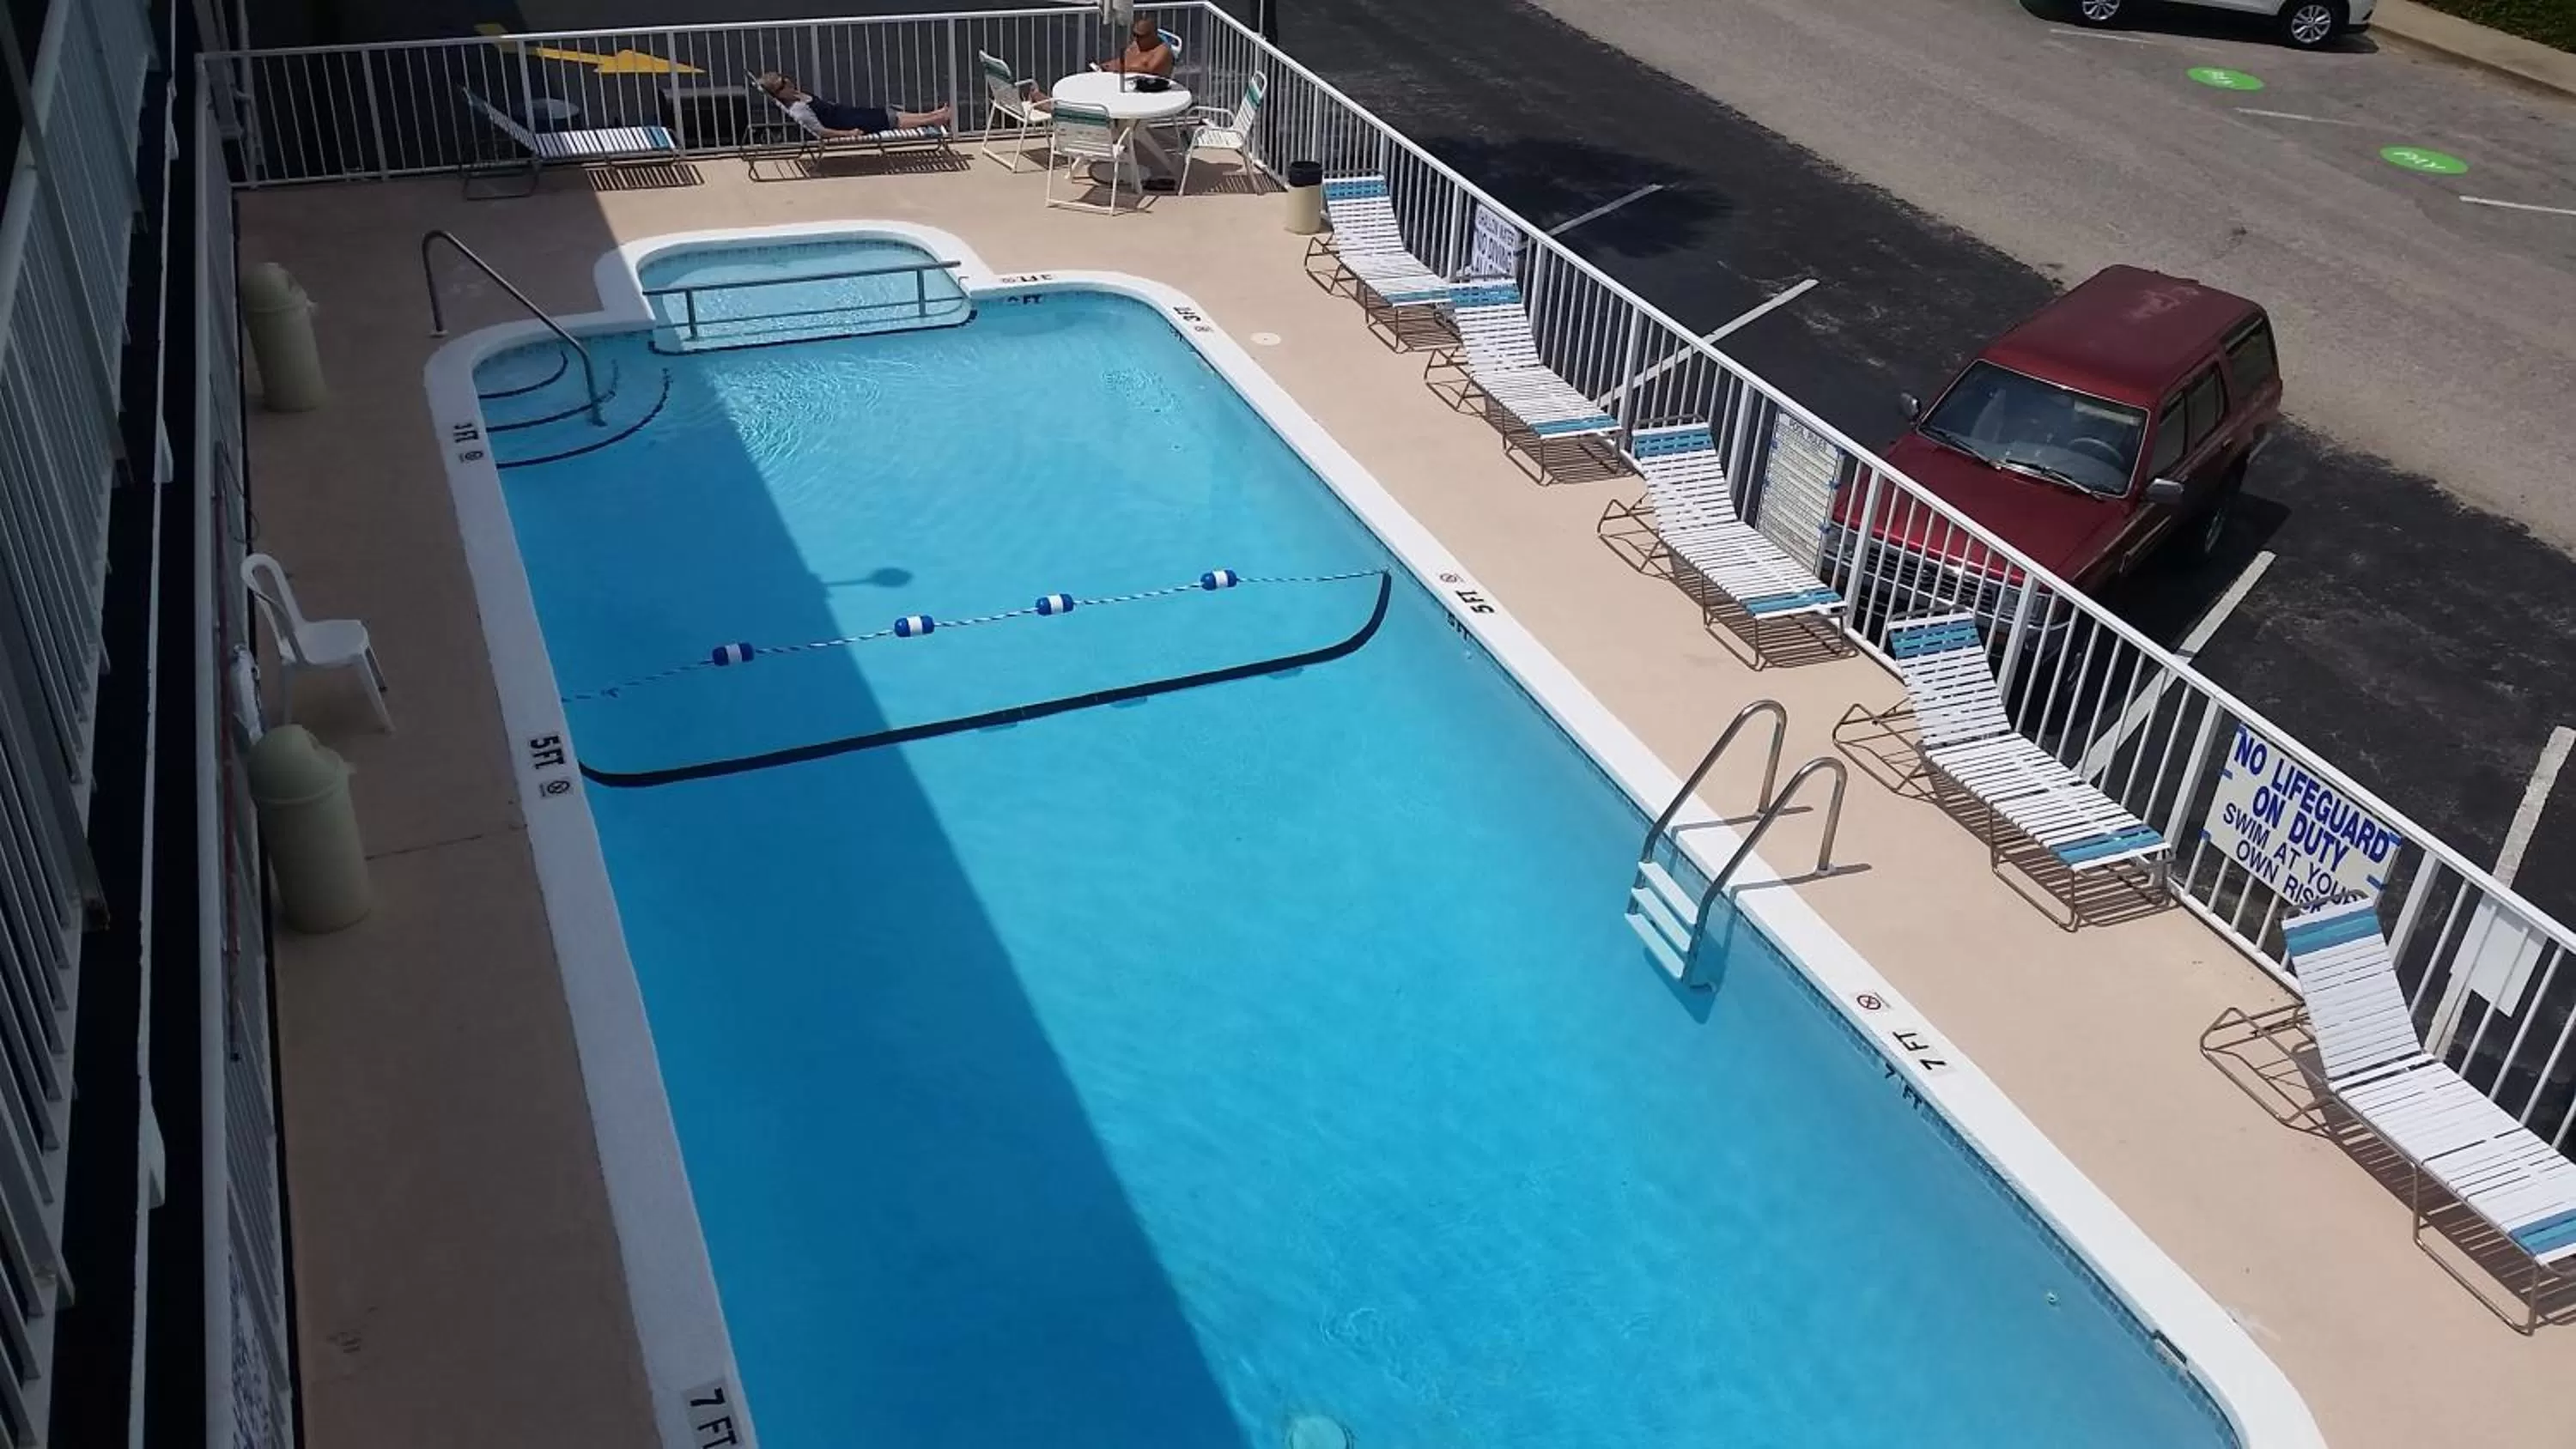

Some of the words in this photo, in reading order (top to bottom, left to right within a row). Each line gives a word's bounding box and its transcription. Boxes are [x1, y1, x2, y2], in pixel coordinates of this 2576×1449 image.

[530, 735, 565, 770] 5FT
[2234, 733, 2267, 775] NO
[2271, 758, 2391, 864] LIFEGUARD
[2223, 802, 2270, 851] SWIM
[2275, 842, 2301, 870] AT
[2252, 785, 2286, 829] ON
[2288, 809, 2349, 873] DUTY
[2236, 840, 2280, 883] OWN
[696, 1415, 738, 1449] FT
